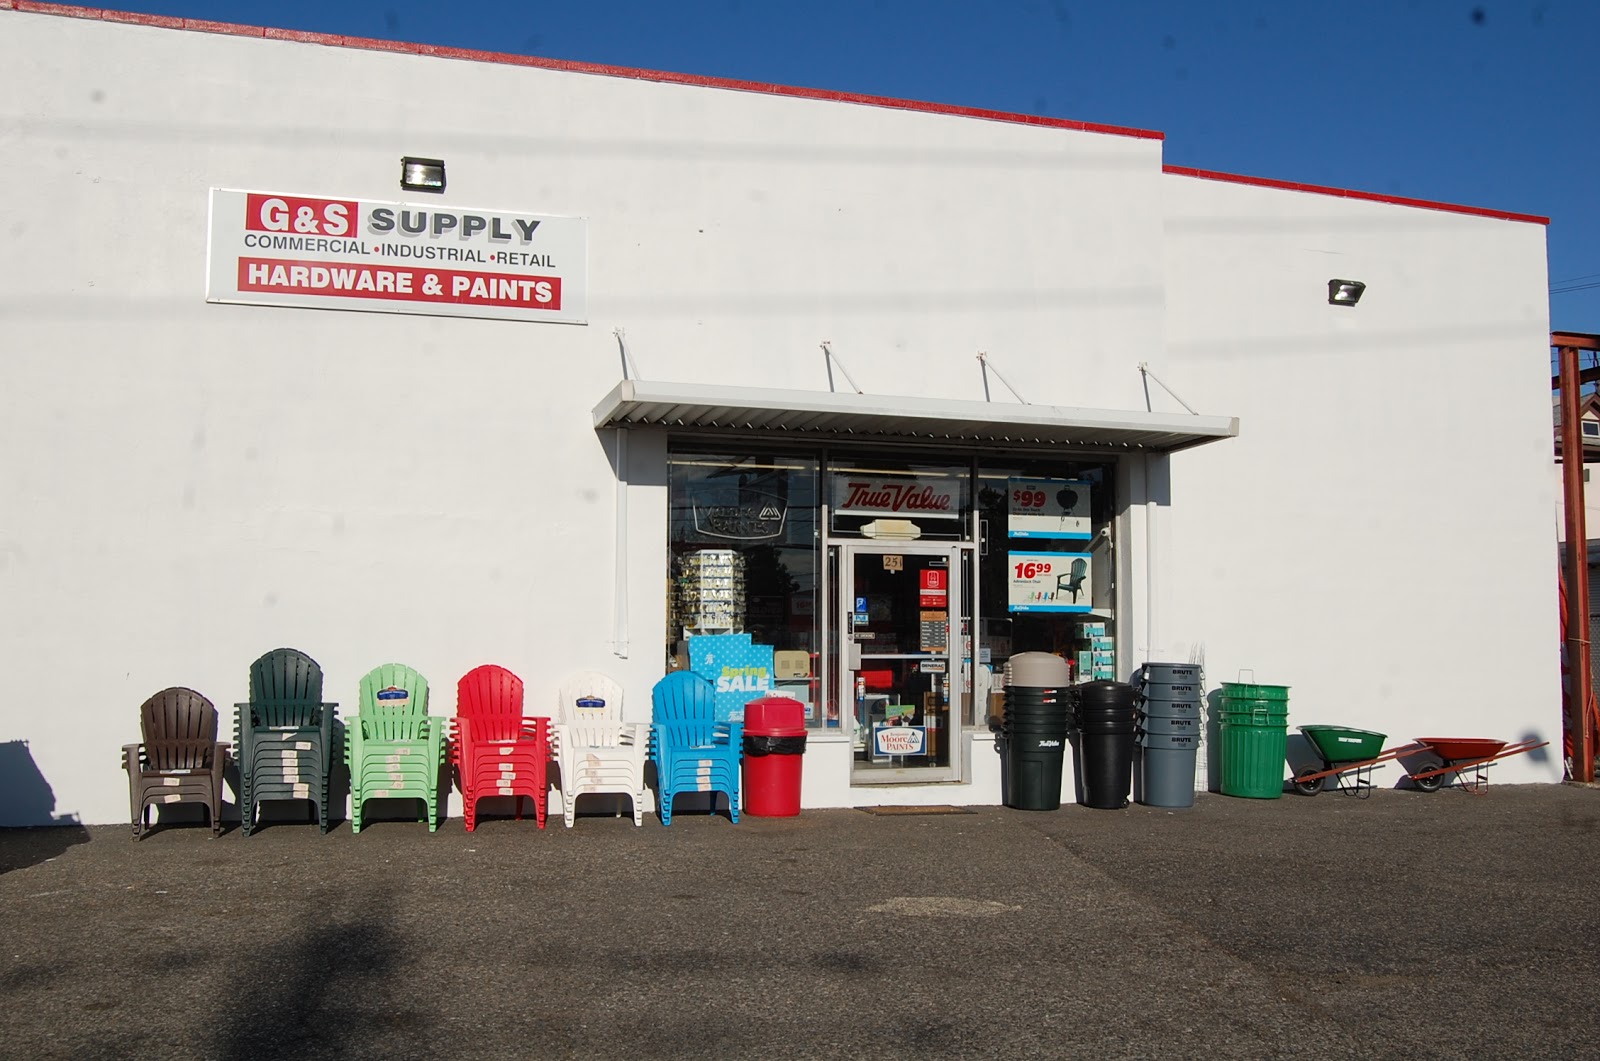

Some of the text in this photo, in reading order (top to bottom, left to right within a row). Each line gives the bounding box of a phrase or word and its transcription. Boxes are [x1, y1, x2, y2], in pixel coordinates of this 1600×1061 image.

[260, 198, 541, 246] G&S SUPPLY
[244, 234, 556, 268] COMMERCIAL INDUSTRIAL RETAIL
[248, 263, 553, 303] HARDWARE & PAINTS
[841, 482, 951, 512] True Value
[716, 675, 770, 693] SALE
[721, 664, 767, 678] Spring
[881, 735, 908, 743] Moore
